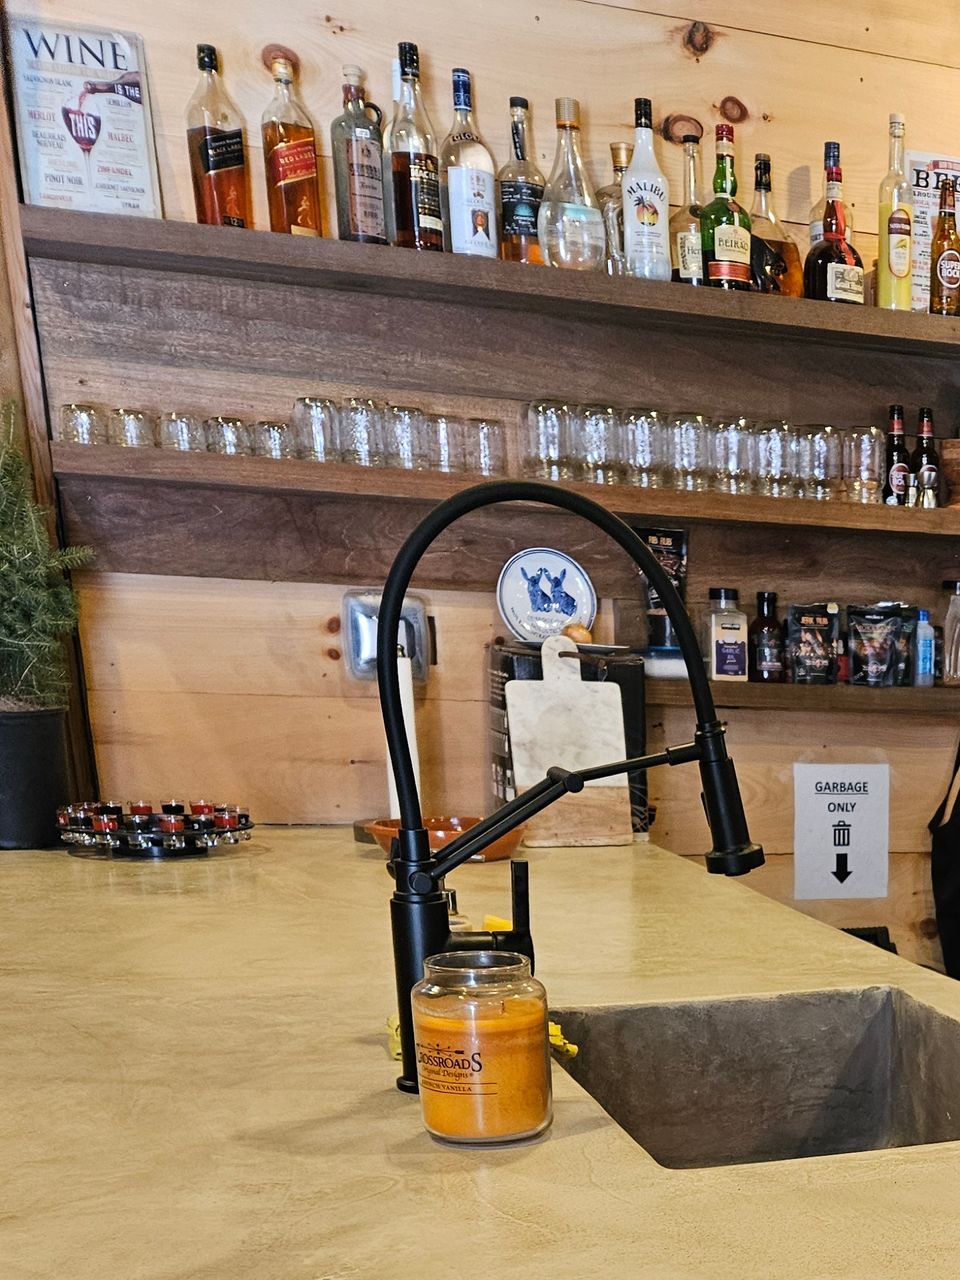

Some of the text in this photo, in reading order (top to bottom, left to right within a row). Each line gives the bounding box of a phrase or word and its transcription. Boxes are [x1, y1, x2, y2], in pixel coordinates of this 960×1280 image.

[22, 28, 128, 71] WINE
[114, 84, 141, 97] IS THE
[68, 112, 96, 139] THIS
[627, 182, 666, 202] MALIBU
[814, 781, 869, 794] GARBAGE
[827, 801, 857, 813] ONLY
[441, 1084, 472, 1093] VANILLA
